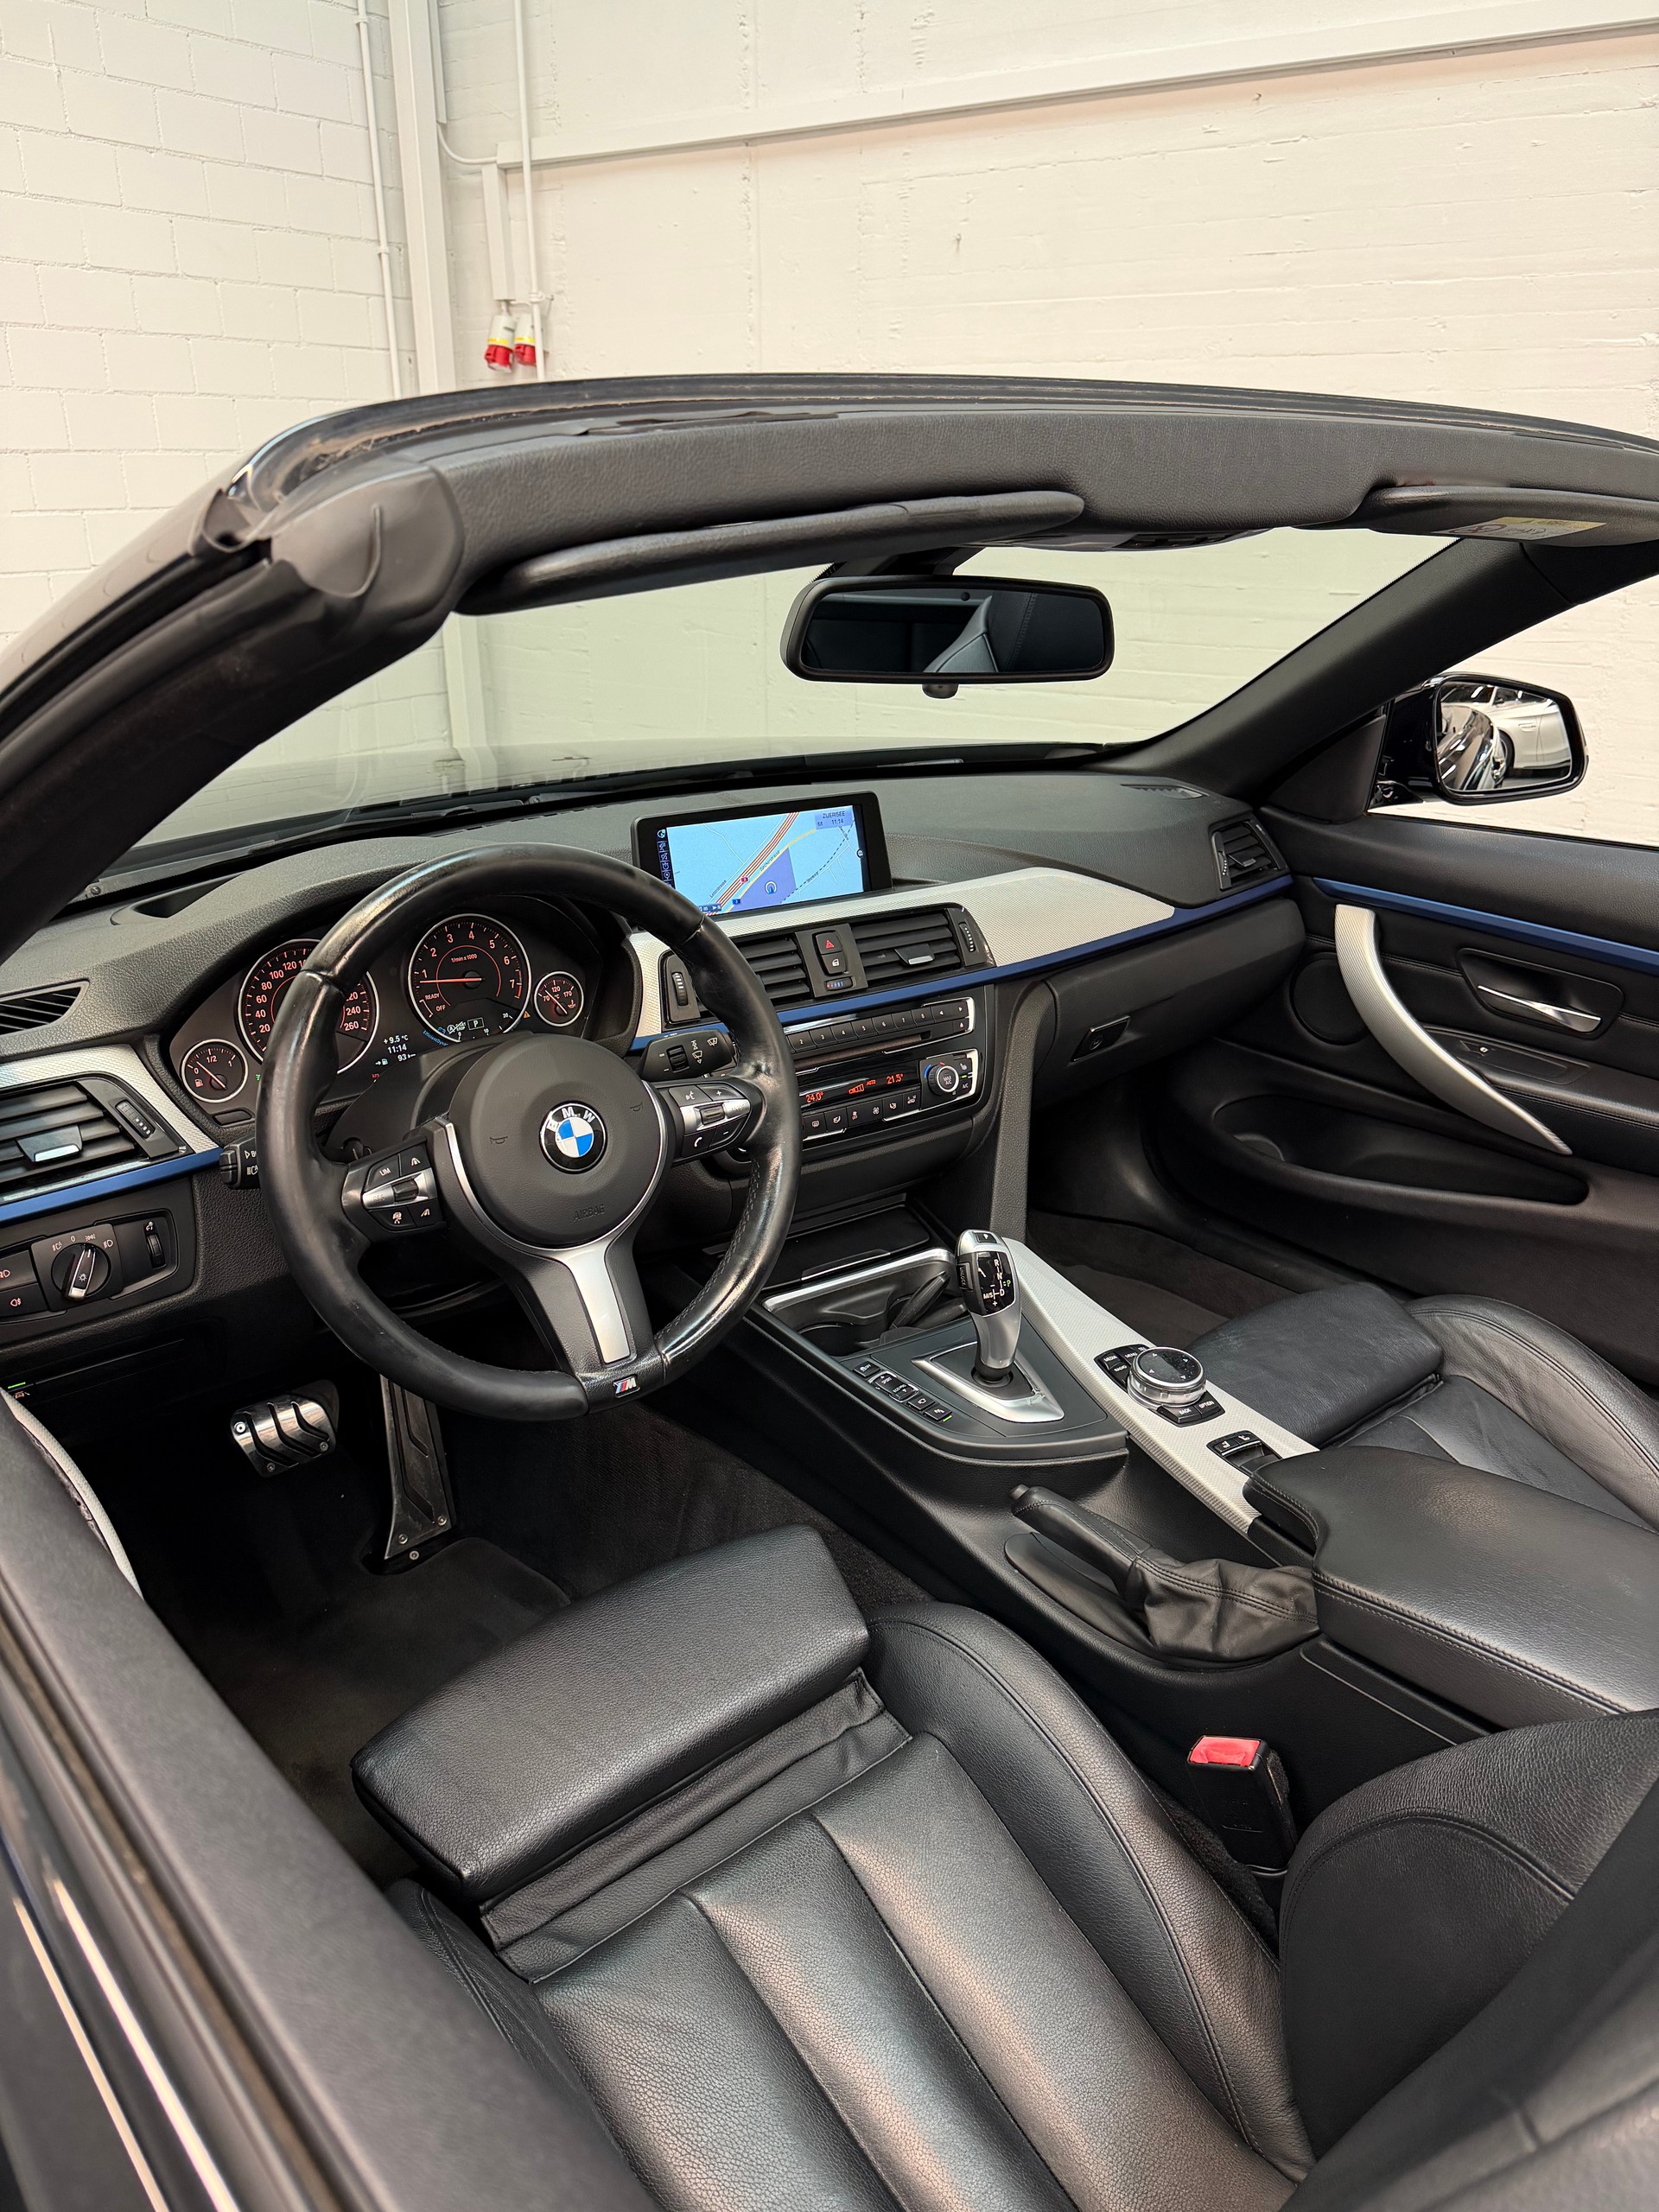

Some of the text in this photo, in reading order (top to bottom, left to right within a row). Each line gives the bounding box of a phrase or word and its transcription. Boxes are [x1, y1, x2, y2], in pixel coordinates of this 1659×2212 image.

[447, 934, 454, 943] 3
[468, 931, 474, 940] 4
[489, 940, 496, 949] 5
[430, 948, 437, 957] 2
[504, 956, 510, 965] 6
[283, 961, 297, 971] 120
[269, 970, 284, 980] 100
[422, 969, 427, 978] 1
[261, 981, 272, 991] 80
[509, 979, 515, 988] 7
[256, 995, 267, 1004] 60
[346, 992, 358, 1001] 20
[255, 1009, 266, 1019] 40
[346, 1006, 361, 1016] 240
[259, 1023, 270, 1033] 20
[344, 1021, 359, 1031] 260
[388, 1043, 407, 1054] 11:14
[546, 1106, 596, 1133] BMW
